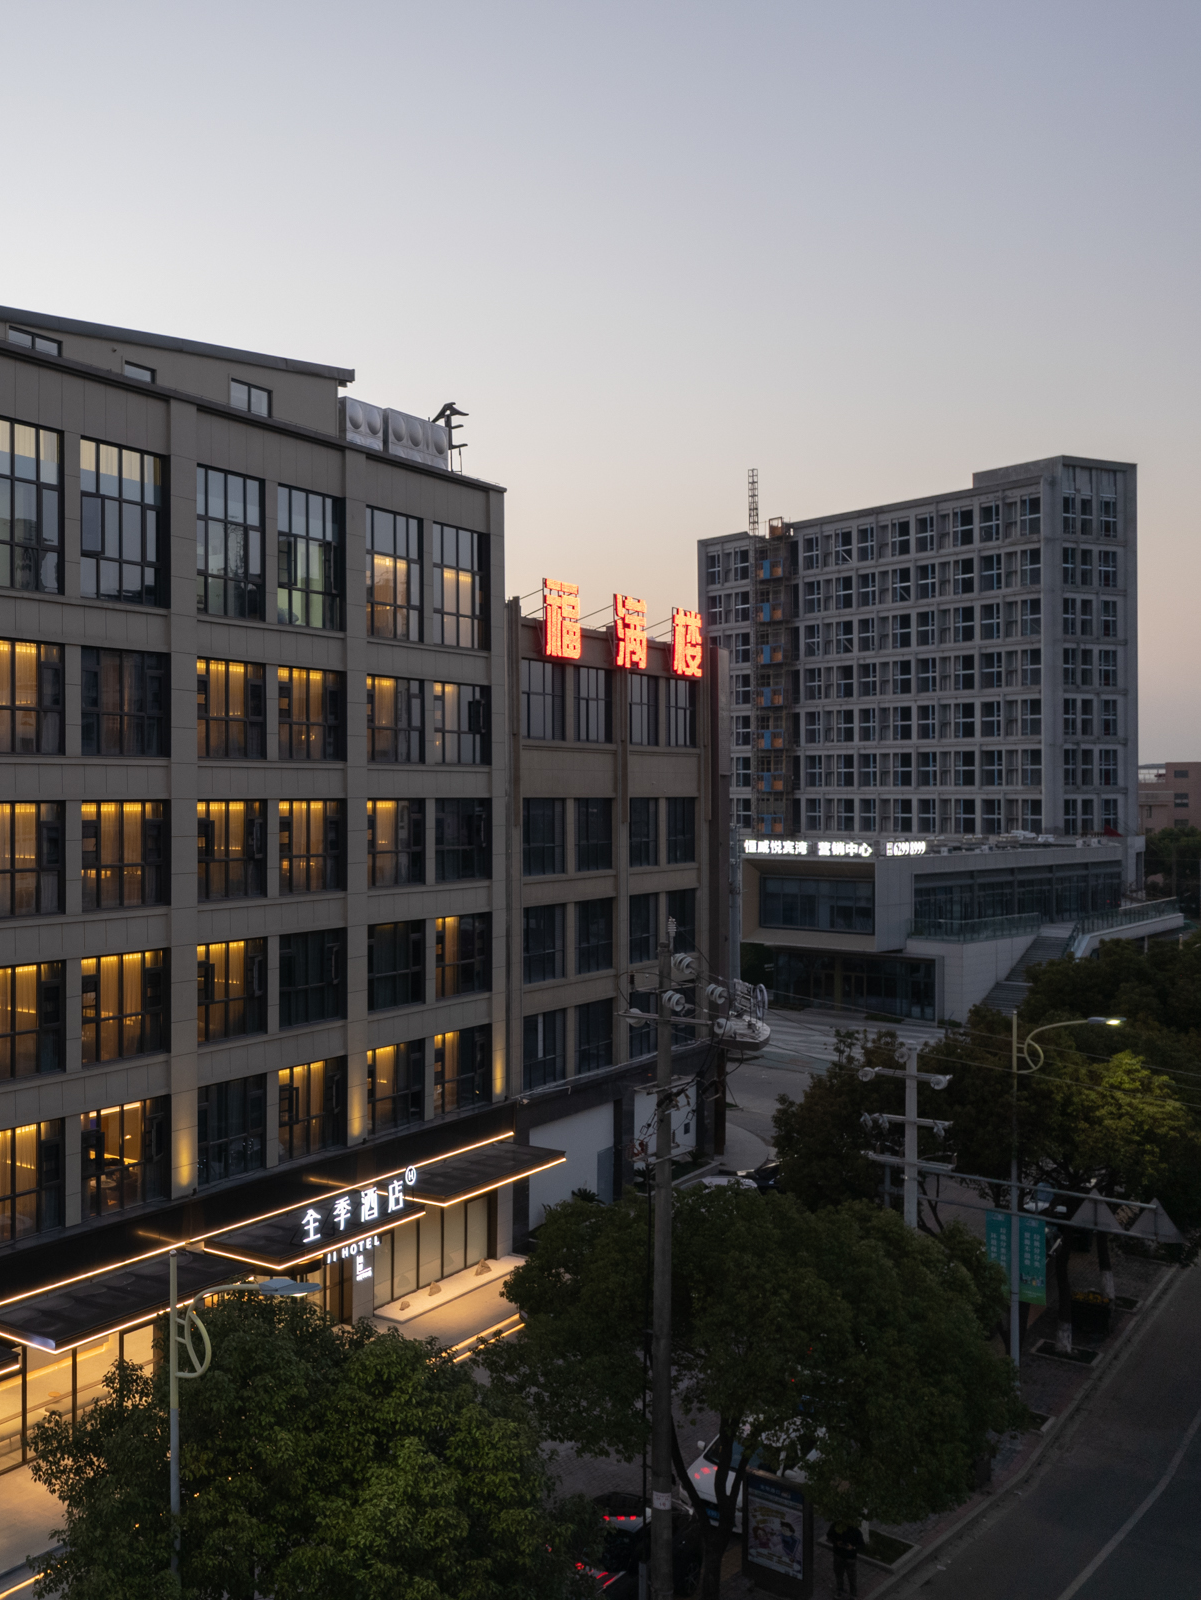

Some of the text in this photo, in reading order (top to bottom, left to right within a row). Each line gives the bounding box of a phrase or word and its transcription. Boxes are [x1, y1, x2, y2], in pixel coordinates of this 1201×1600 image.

[543, 577, 703, 678] 福满楼
[817, 841, 874, 858] 营销中心
[301, 1179, 405, 1244] 全季酒店
[341, 1235, 381, 1259] HOTEL
